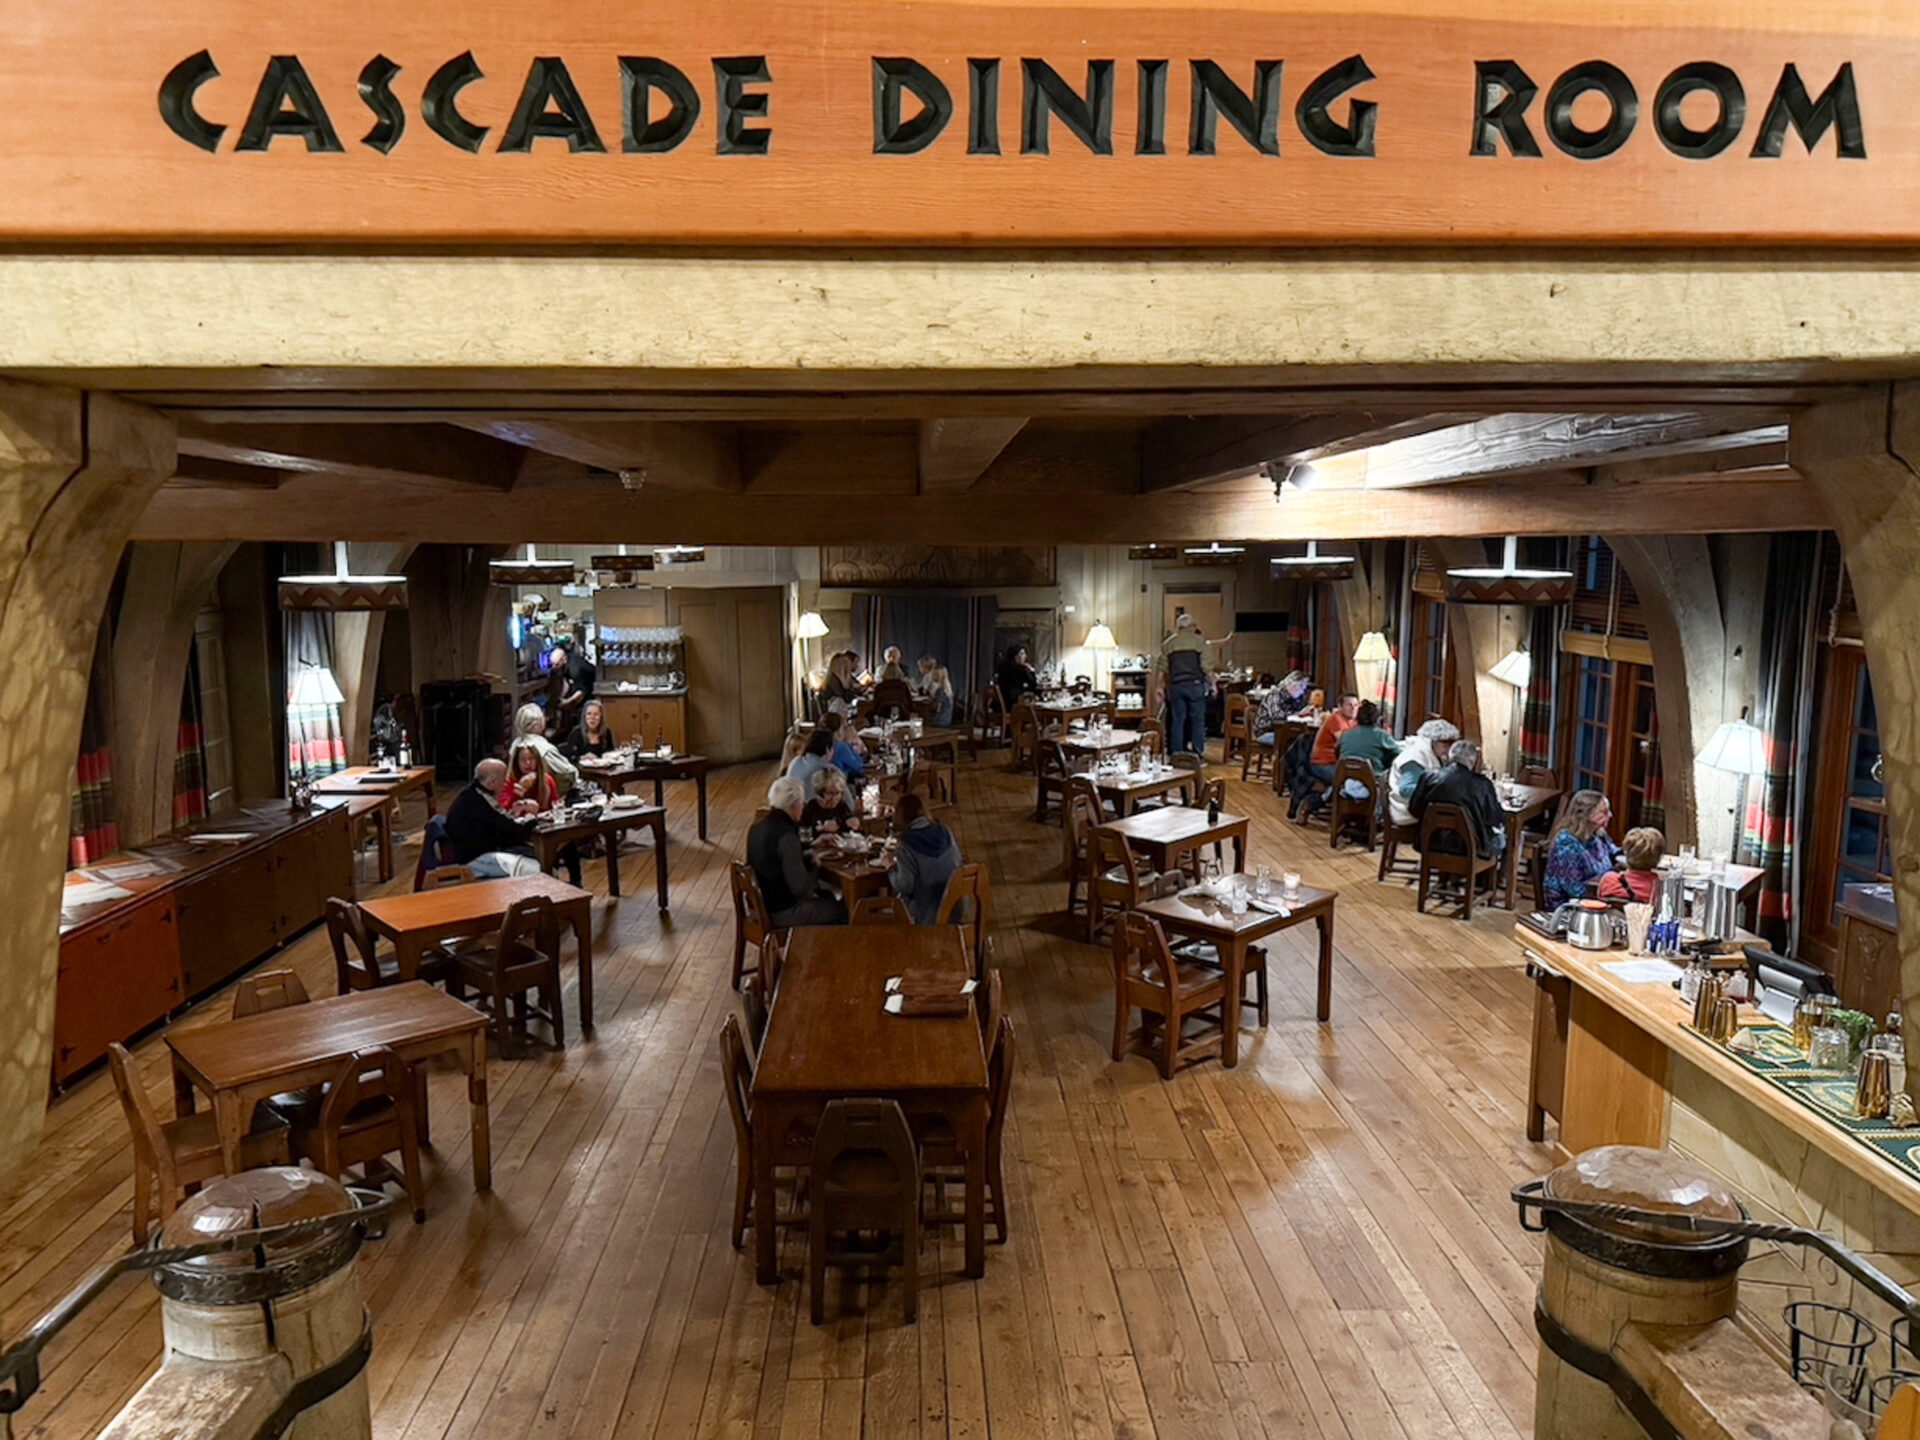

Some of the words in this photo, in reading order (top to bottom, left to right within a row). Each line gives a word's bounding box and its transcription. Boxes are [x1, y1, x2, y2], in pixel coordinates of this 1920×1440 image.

[158, 49, 772, 155] CASCADE
[872, 54, 1377, 157] DINING
[1469, 59, 1866, 159] ROOM
